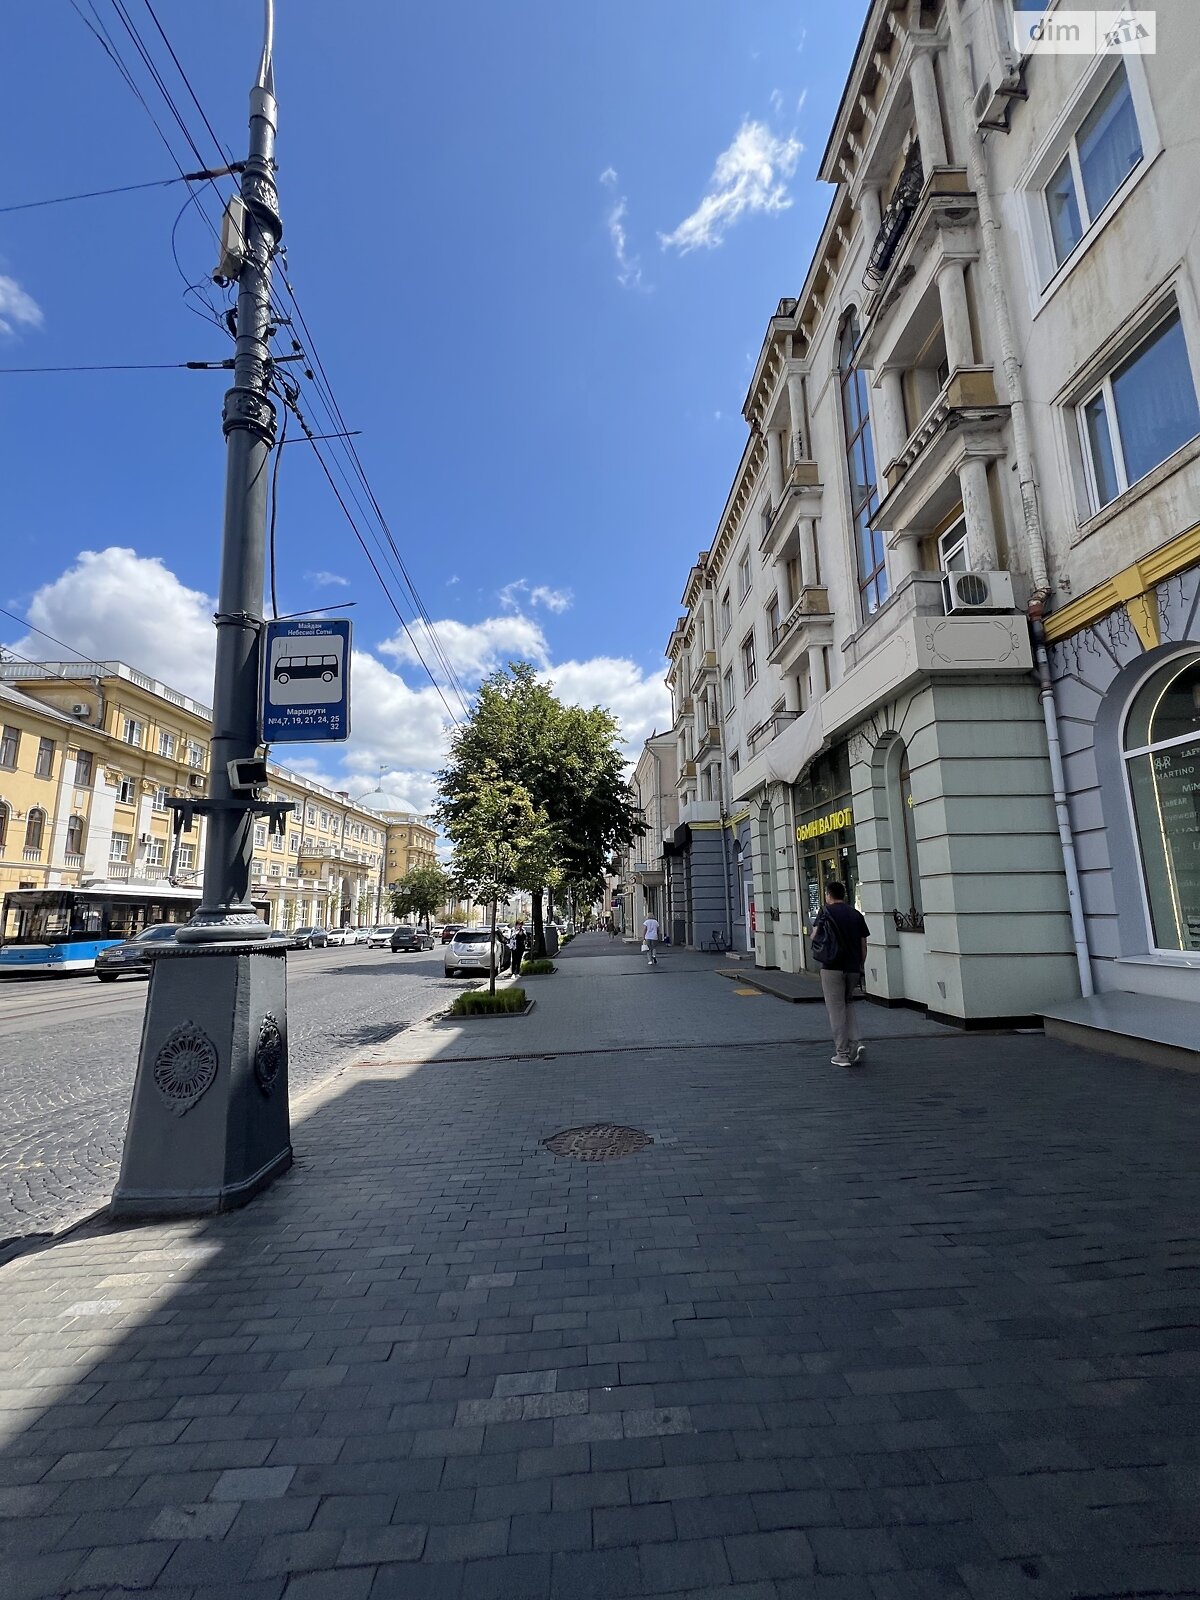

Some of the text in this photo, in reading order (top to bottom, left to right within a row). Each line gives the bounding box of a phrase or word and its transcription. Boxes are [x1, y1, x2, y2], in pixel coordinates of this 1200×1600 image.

[287, 708, 326, 716] Маршрути
[292, 717, 303, 725] 19,
[304, 716, 316, 724] 21,
[317, 716, 329, 724] 24,
[330, 715, 340, 723] 25
[1156, 766, 1195, 780] MARTINO
